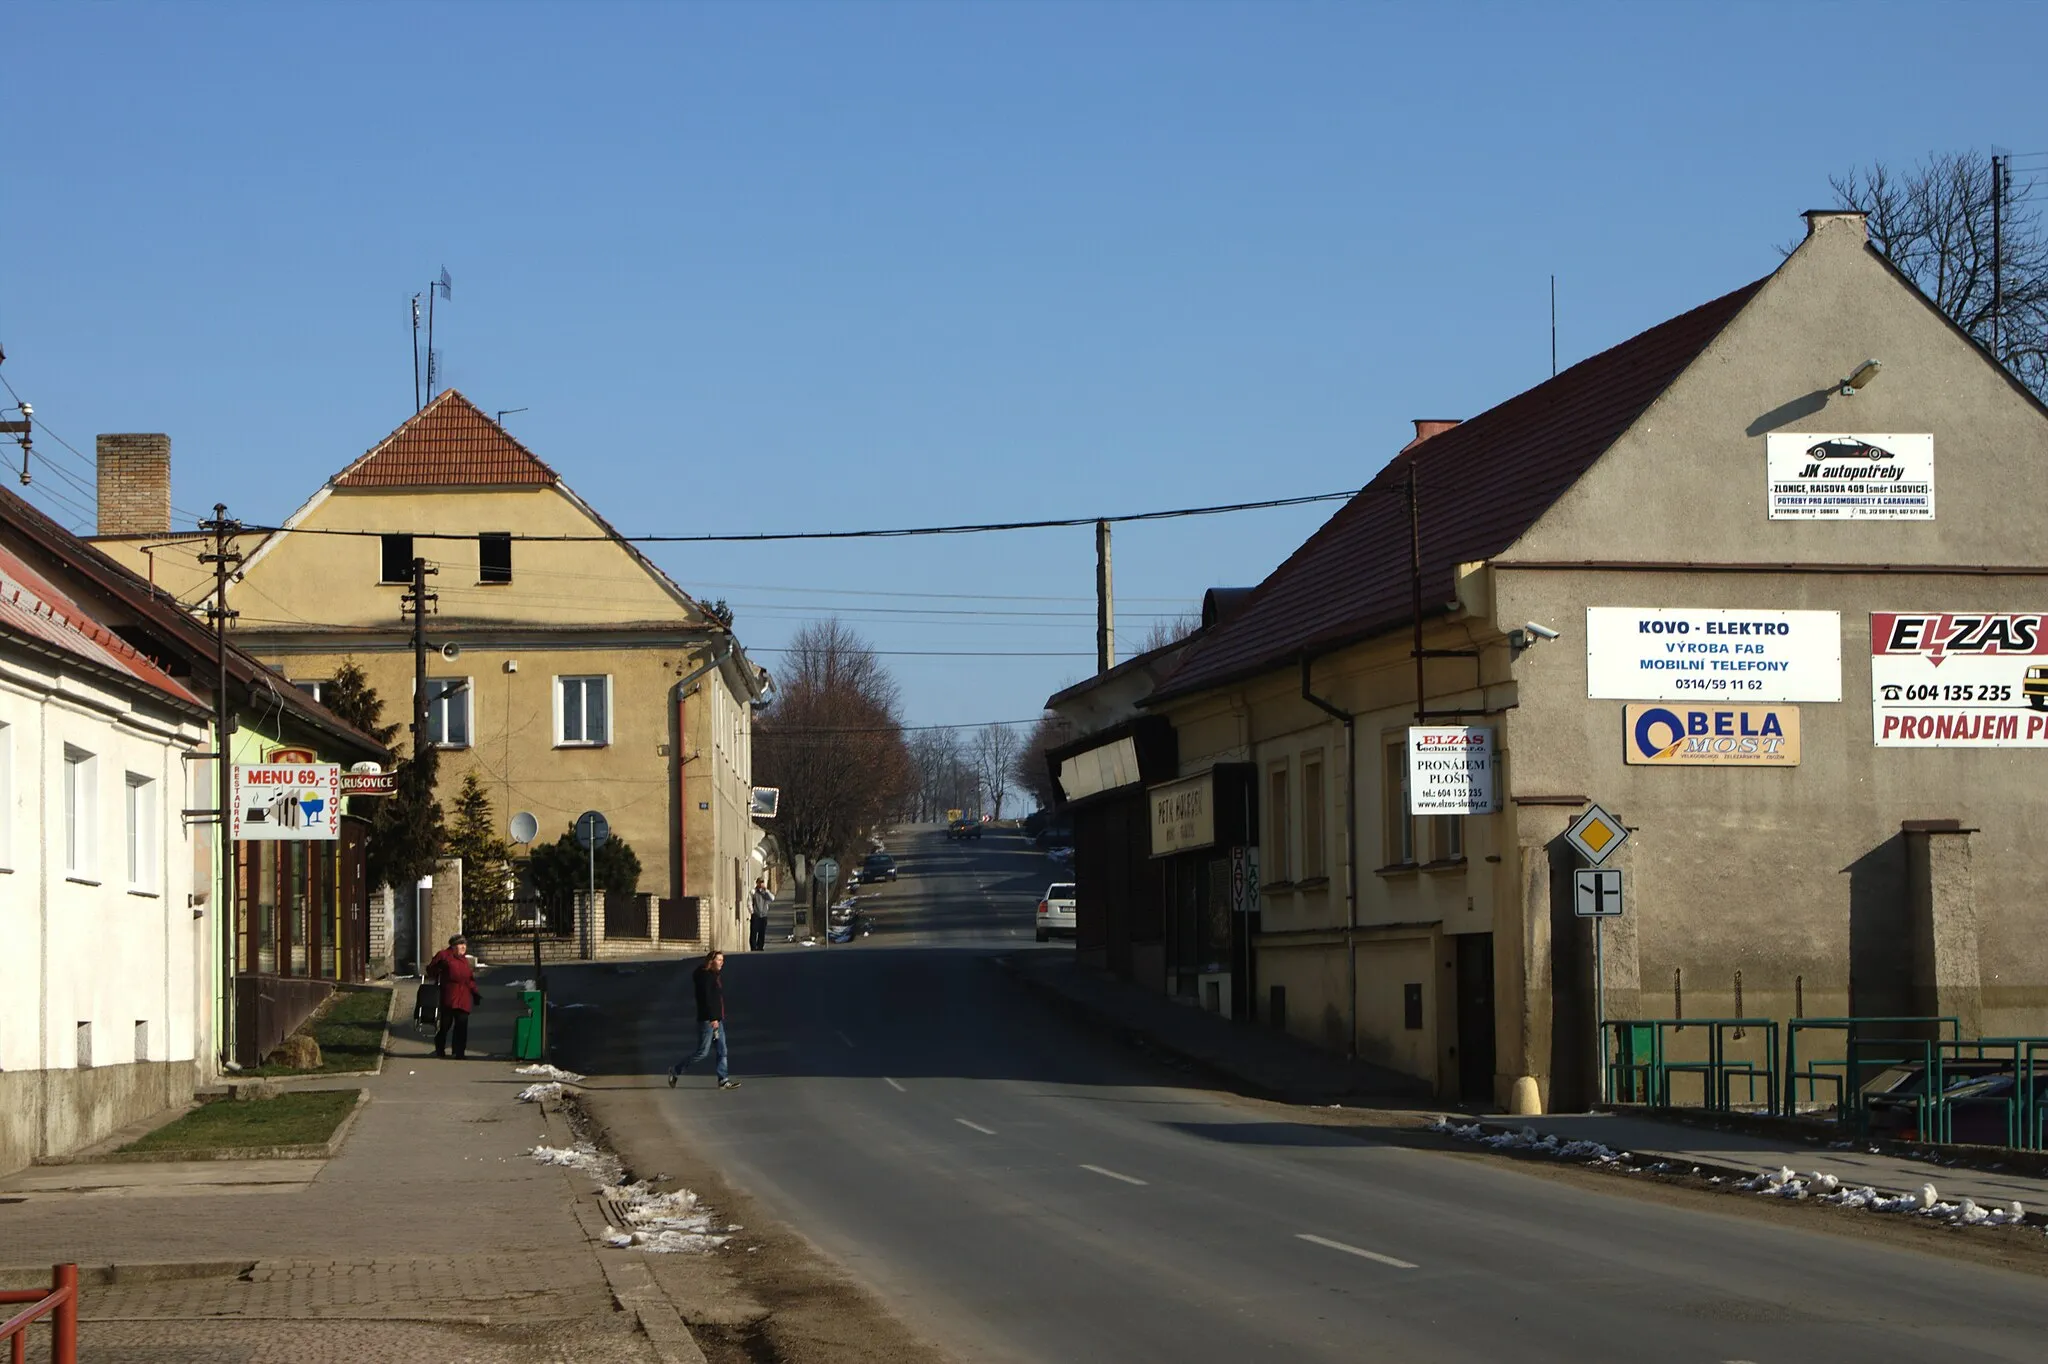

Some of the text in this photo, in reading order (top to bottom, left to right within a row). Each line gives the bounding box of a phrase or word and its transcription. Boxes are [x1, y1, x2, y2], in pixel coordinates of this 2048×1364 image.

[1799, 464, 1905, 481] JK autopotřeby
[1774, 484, 1808, 494] ZLONICE,
[1810, 484, 1845, 493] RAISOVA
[1848, 484, 1864, 493] 409
[1808, 497, 1822, 505] PRO
[1823, 497, 1875, 505] AUTOMOBILISTY
[1877, 497, 1882, 505] A
[1884, 497, 1925, 505] CARAVANING
[1639, 620, 1689, 634] KOVO
[1707, 622, 1789, 635] ELEKTRO
[1885, 615, 2041, 654] ELZAS
[1666, 641, 1764, 654] VÝROBA FAB
[1640, 658, 1789, 672] MOBILNÍ TELEFONY
[1675, 679, 1762, 690] 0314/59 11 62
[1906, 684, 2011, 701] 604 135 235
[1688, 712, 1783, 736] BELA
[1882, 711, 2048, 739] PRONÁJEM P
[1423, 735, 1484, 744] ELZAS
[1684, 737, 1785, 753] MOST
[1418, 758, 1484, 770] PRONÁJEM
[248, 770, 324, 787] MENU 69,-
[1430, 772, 1473, 783] PLOŠIN
[1438, 789, 1451, 797] 604
[1454, 789, 1466, 797] 135
[1469, 789, 1482, 797] 235
[330, 768, 338, 834] HOTOVKY
[1234, 848, 1243, 910] BARVY
[1249, 855, 1258, 907] LAKY
